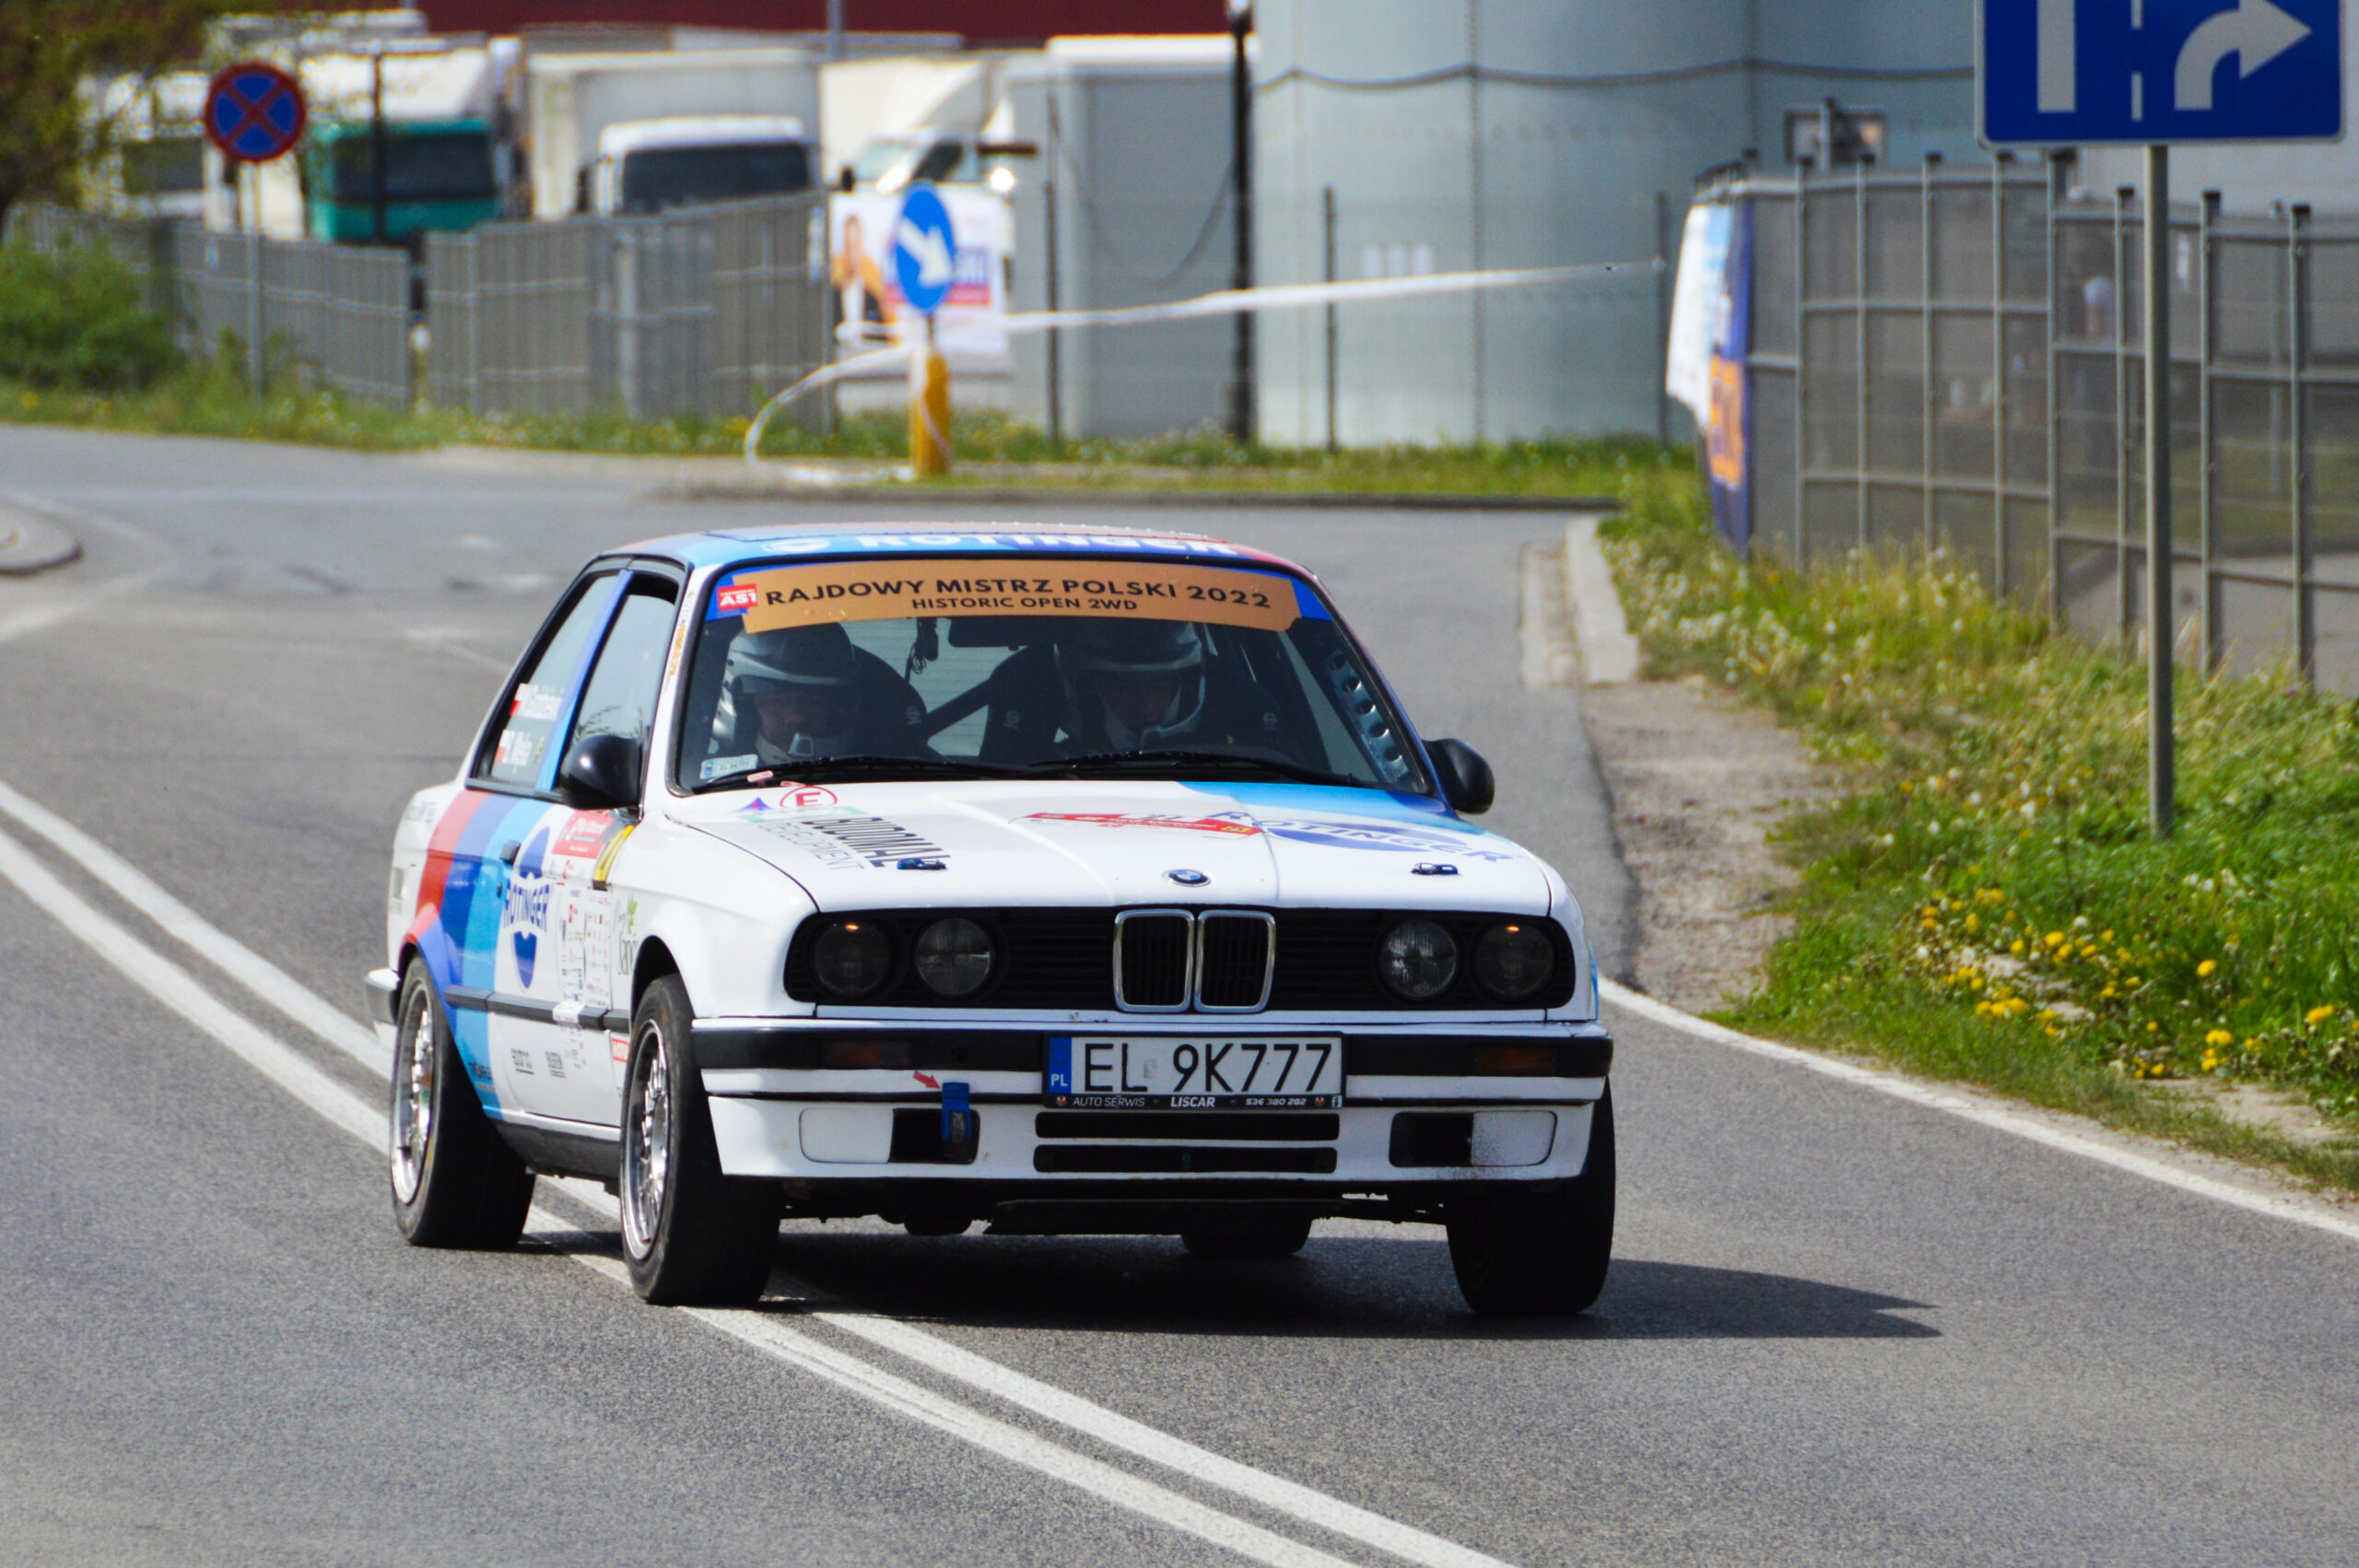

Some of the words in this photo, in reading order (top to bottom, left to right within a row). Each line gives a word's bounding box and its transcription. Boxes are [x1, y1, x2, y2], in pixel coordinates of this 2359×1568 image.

[766, 579, 925, 605] RAJDOWY
[935, 579, 1053, 593] MISTRZ
[1062, 579, 1177, 598] POLSKI
[1186, 585, 1271, 608] 2022
[911, 597, 1015, 610] HISTORIC
[1021, 597, 1081, 609] OPEN
[1089, 598, 1138, 610] 2WD
[1084, 1043, 1148, 1093] EL
[1172, 1043, 1332, 1093] 9K777
[1050, 1073, 1069, 1087] PL
[1073, 1096, 1102, 1106] AUTO
[1104, 1096, 1145, 1106] SERWIS
[1169, 1096, 1215, 1107] LISCAR
